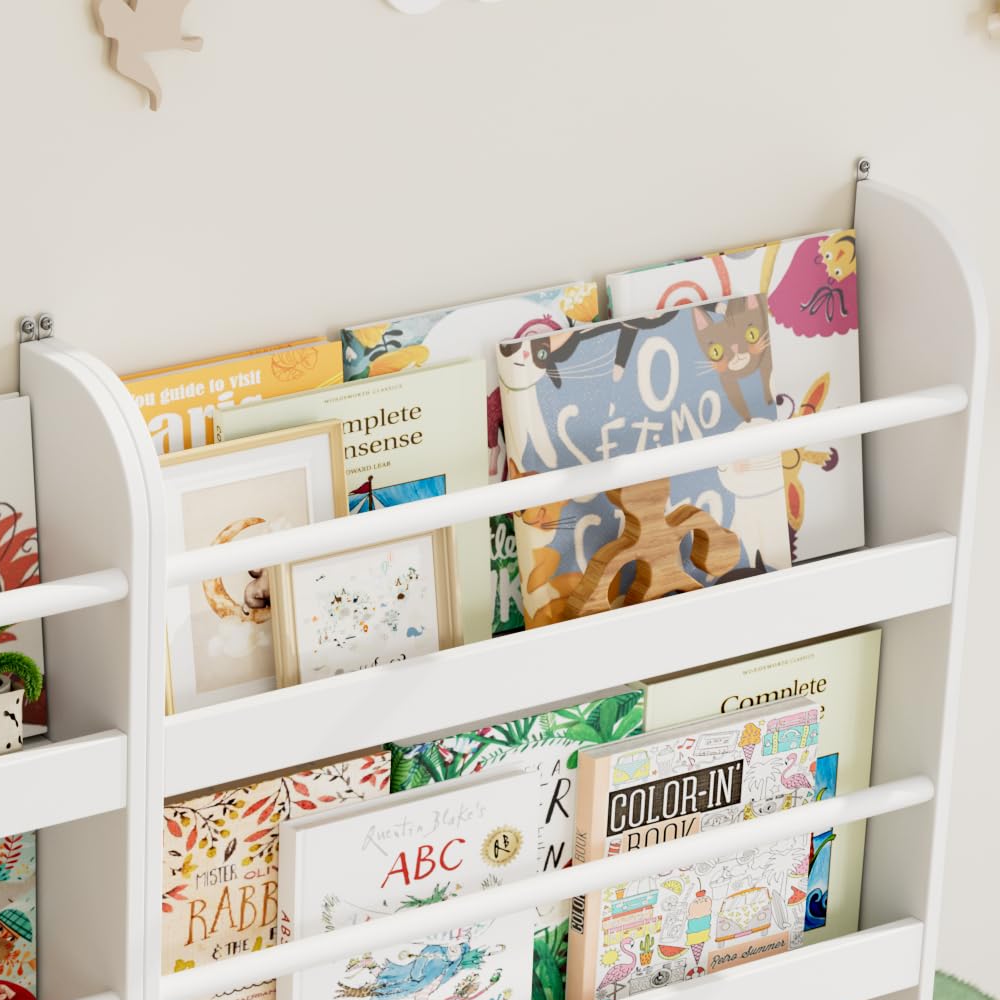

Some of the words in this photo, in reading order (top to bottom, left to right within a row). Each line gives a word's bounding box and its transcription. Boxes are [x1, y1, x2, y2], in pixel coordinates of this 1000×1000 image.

[160, 383, 205, 405] guide
[209, 378, 225, 393] to
[229, 371, 261, 389] visit
[637, 336, 679, 412] O
[196, 864, 239, 890] MISTER
[380, 838, 466, 888] ABC
[184, 881, 278, 947] RABB
[226, 938, 249, 955] THE
[741, 940, 786, 959] Summer
